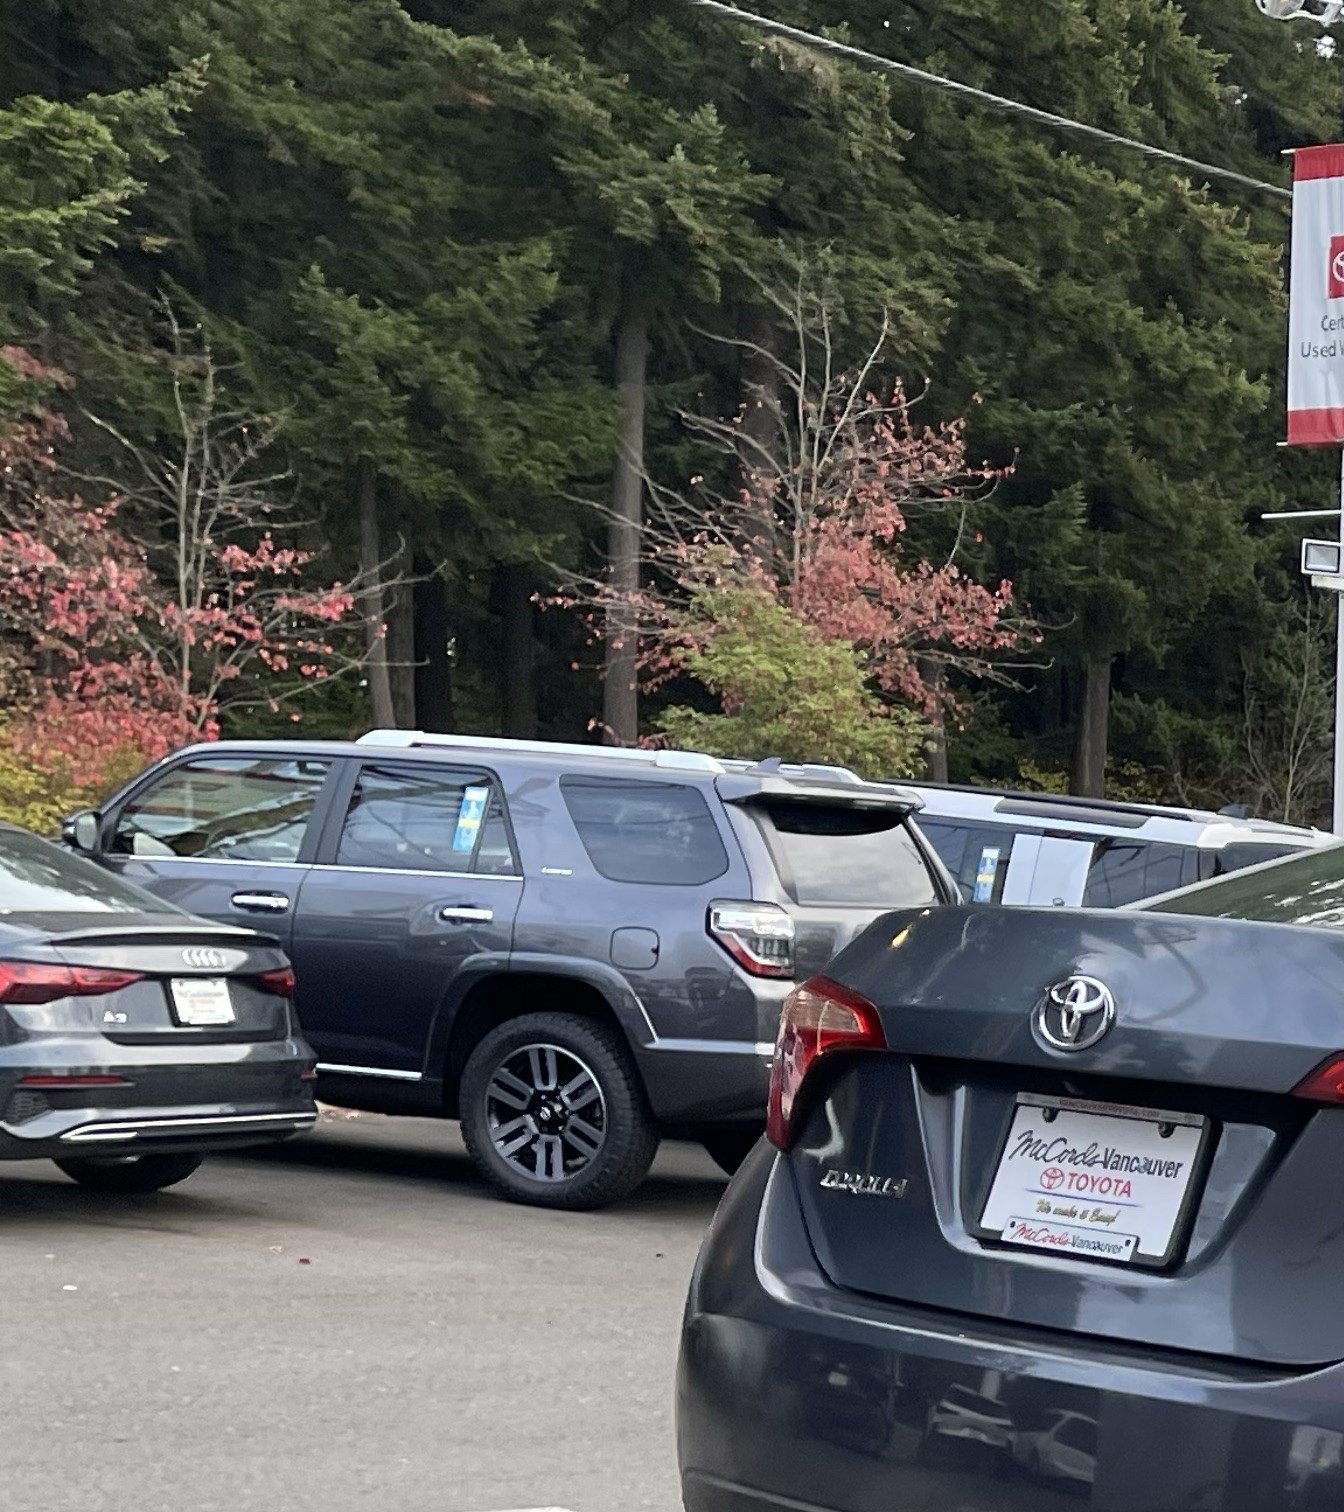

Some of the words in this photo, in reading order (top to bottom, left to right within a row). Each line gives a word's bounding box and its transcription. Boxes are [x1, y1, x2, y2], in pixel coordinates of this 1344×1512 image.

[1301, 340, 1336, 358] Used
[1101, 1147, 1184, 1179] Vancouver
[1066, 1172, 1133, 1198] TOYOTA
